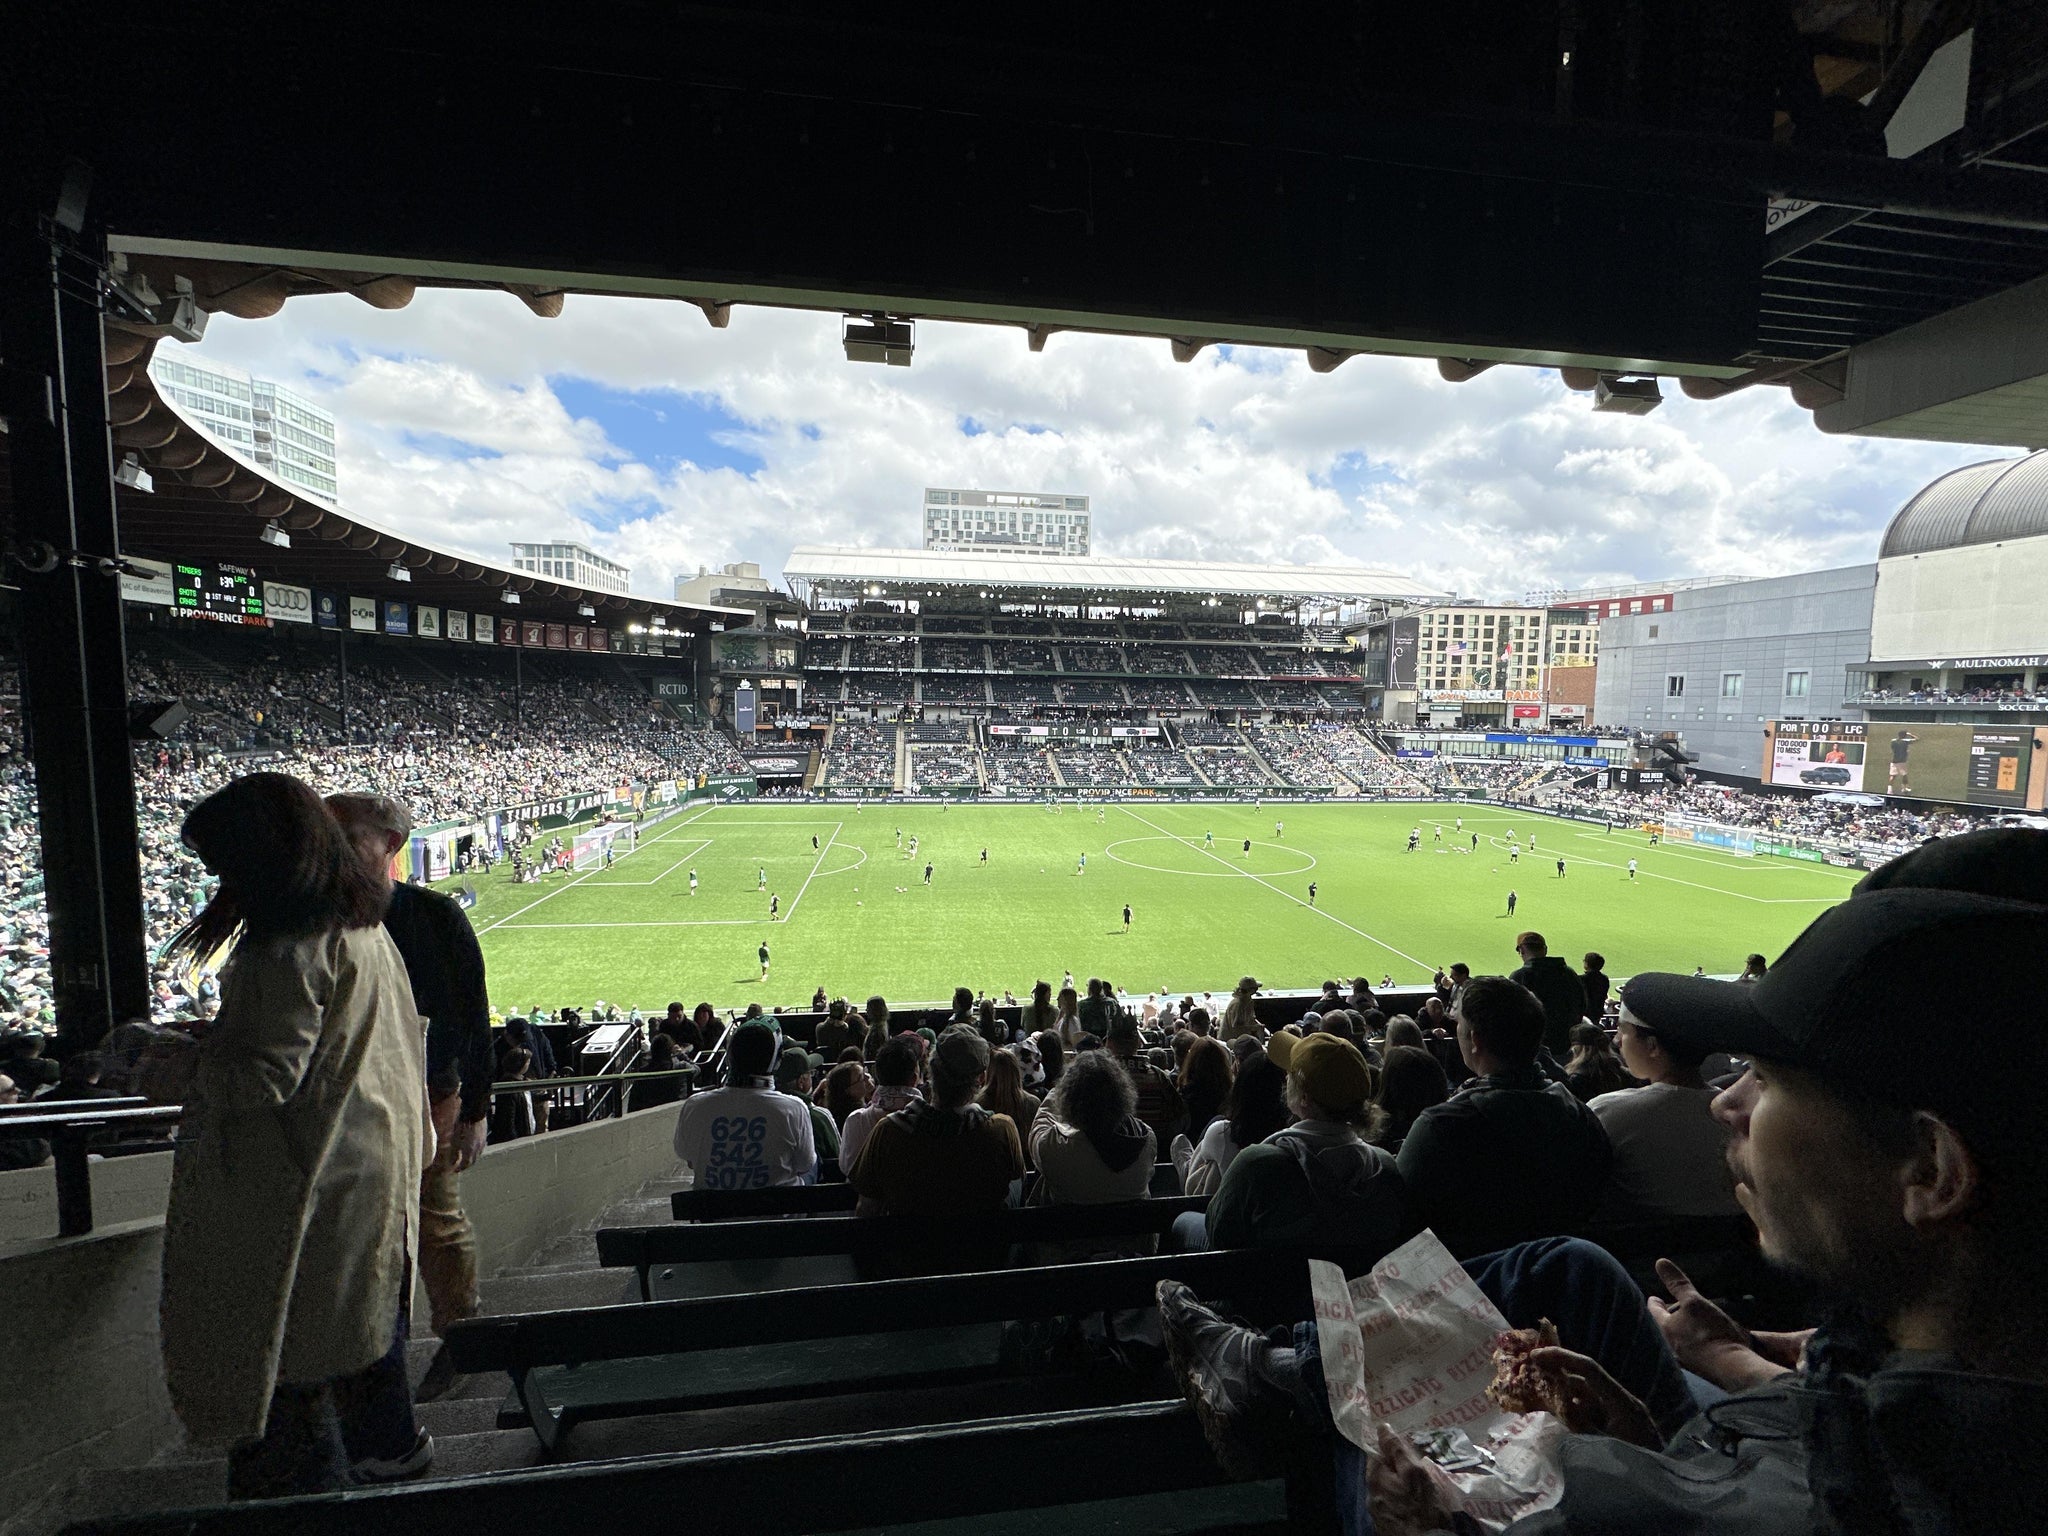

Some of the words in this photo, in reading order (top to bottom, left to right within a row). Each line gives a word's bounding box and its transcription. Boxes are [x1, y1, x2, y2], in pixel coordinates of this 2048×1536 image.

[177, 565, 202, 576] TIMBERS
[218, 562, 249, 576] SAFEWAY
[194, 577, 201, 588] 0
[234, 575, 247, 584] LAFC
[134, 583, 141, 591] of
[141, 585, 172, 595] Beaverton
[178, 588, 197, 597] SHOTS
[248, 586, 255, 597] 0
[212, 592, 222, 600] 1ST
[223, 594, 237, 603] HALF
[265, 608, 280, 617] Audi
[280, 610, 309, 619] Beaverton
[449, 611, 466, 620] HOUSE
[385, 620, 408, 628] axiom
[450, 630, 465, 639] WINE
[1954, 657, 2039, 669] MULTNOMAH
[659, 683, 688, 695] RCTID
[1422, 689, 1503, 700] PROVIDENCE
[1505, 689, 1542, 701] PARK
[1062, 727, 1069, 736] 0
[1092, 727, 1098, 736] 0
[1780, 723, 1798, 732] POR
[1812, 723, 1819, 732] 0
[1821, 723, 1829, 733] 0
[1844, 725, 1863, 734] LFC
[1790, 740, 1808, 748] GOOD
[506, 801, 563, 823] TIMBERS
[578, 792, 609, 810] ARMY
[1755, 843, 1781, 855] chime
[1789, 849, 1817, 861] chime
[1822, 854, 1856, 864] DISCOUNT
[710, 1116, 768, 1142] 626
[709, 1142, 764, 1167] 542
[705, 1164, 769, 1190] 5075
